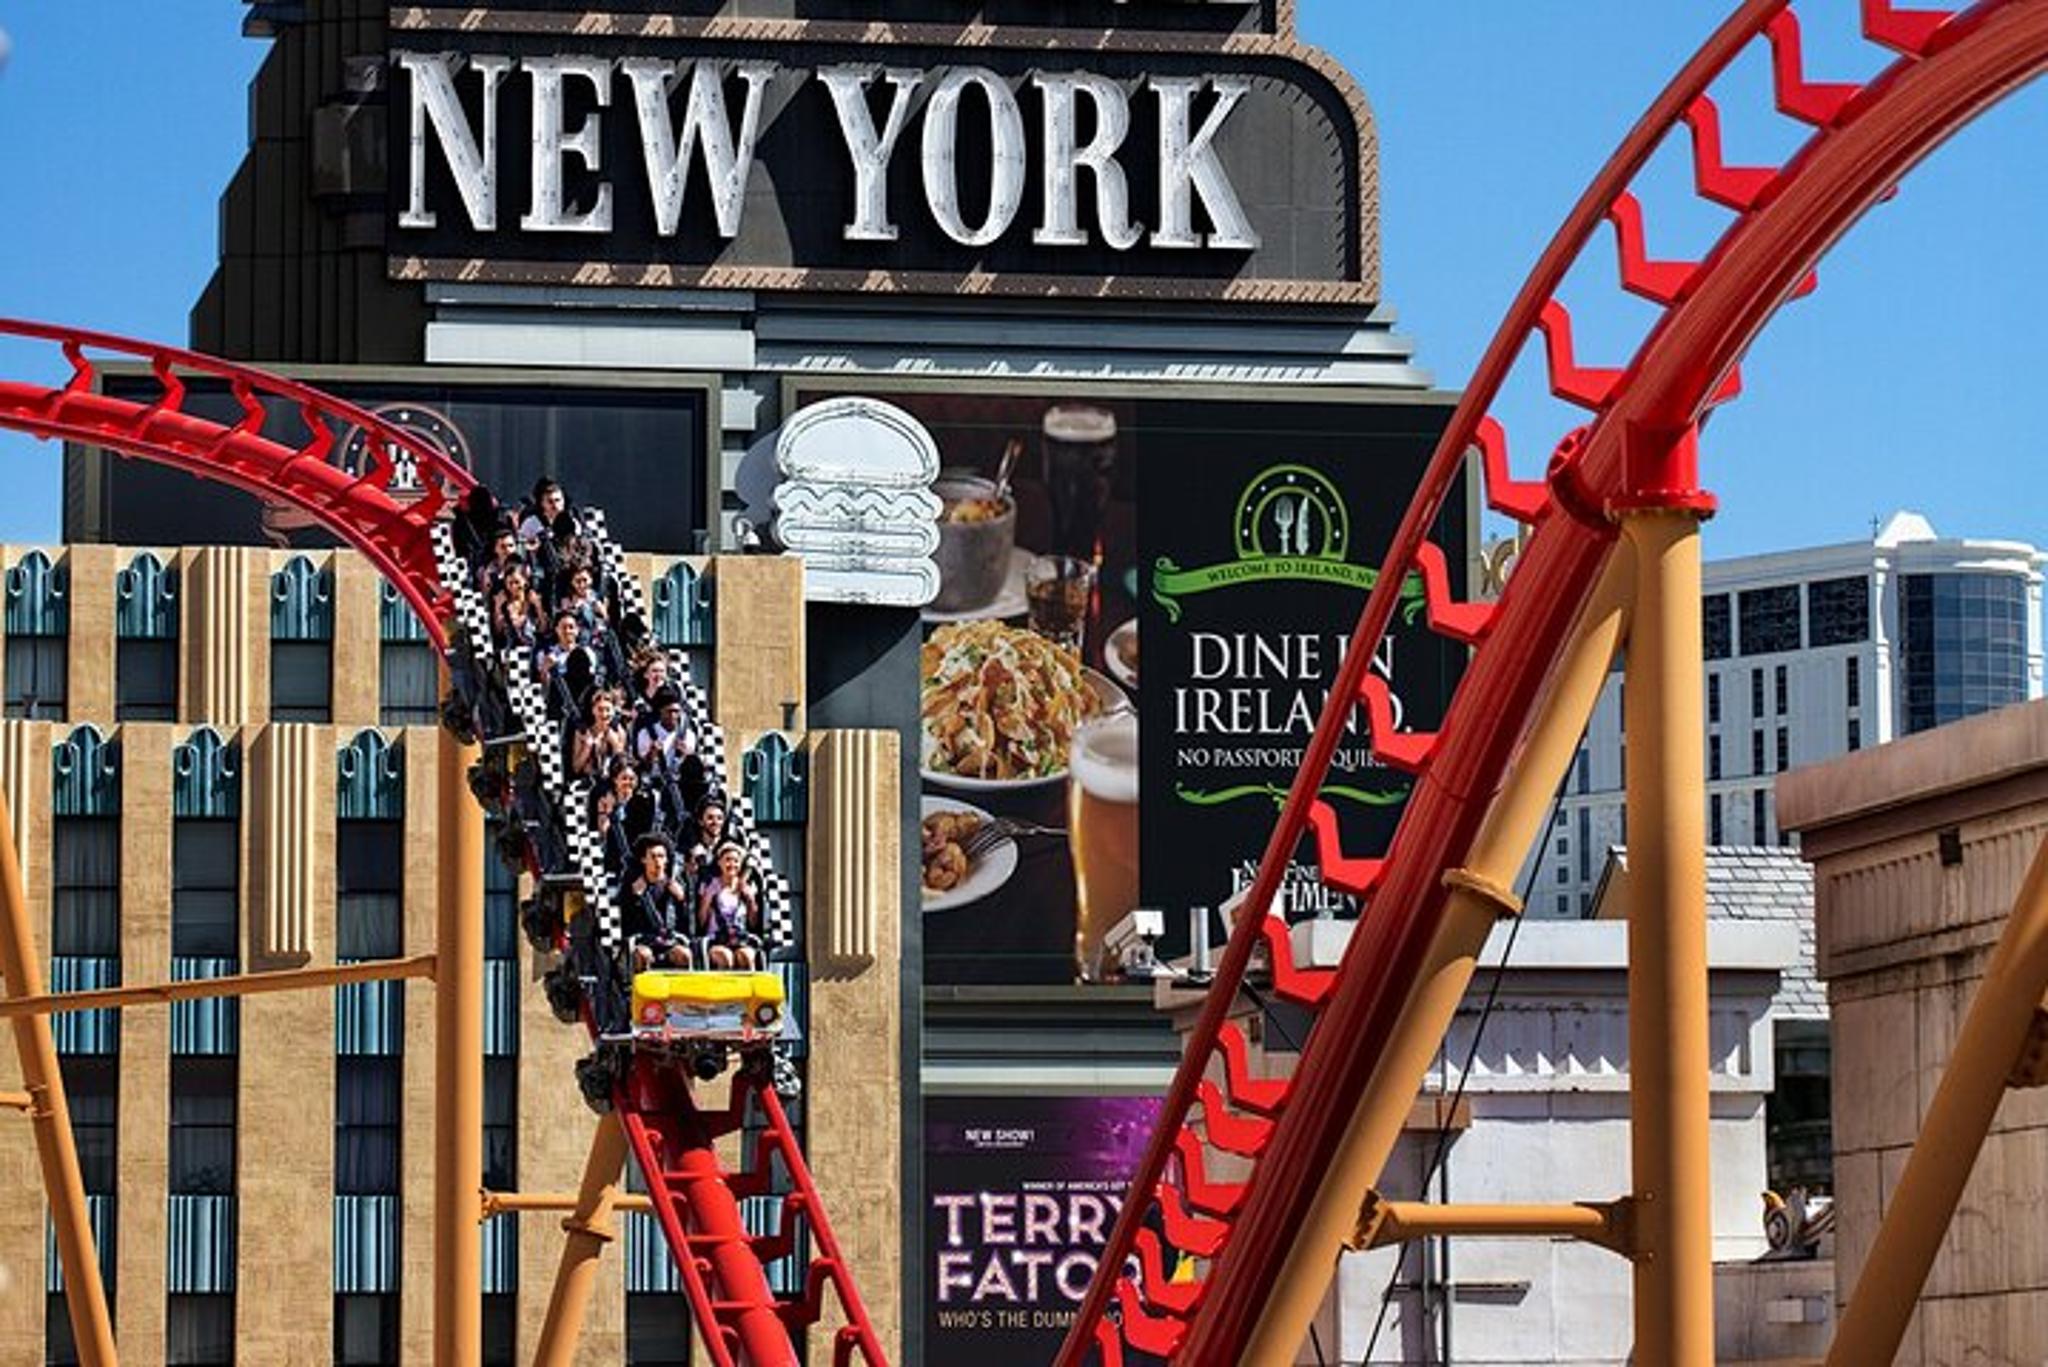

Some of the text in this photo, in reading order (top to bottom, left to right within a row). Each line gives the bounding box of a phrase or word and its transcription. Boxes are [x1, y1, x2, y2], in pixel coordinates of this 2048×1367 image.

[399, 52, 1261, 249] NEW YORK
[1207, 561, 1269, 582] WELCOME
[1274, 561, 1291, 573] TO
[1190, 634, 1320, 679] DINE
[1177, 748, 1210, 768] NO
[965, 1129, 992, 1141] NEW
[938, 1311, 992, 1328] WHO'S
[998, 1311, 1028, 1328] THE
